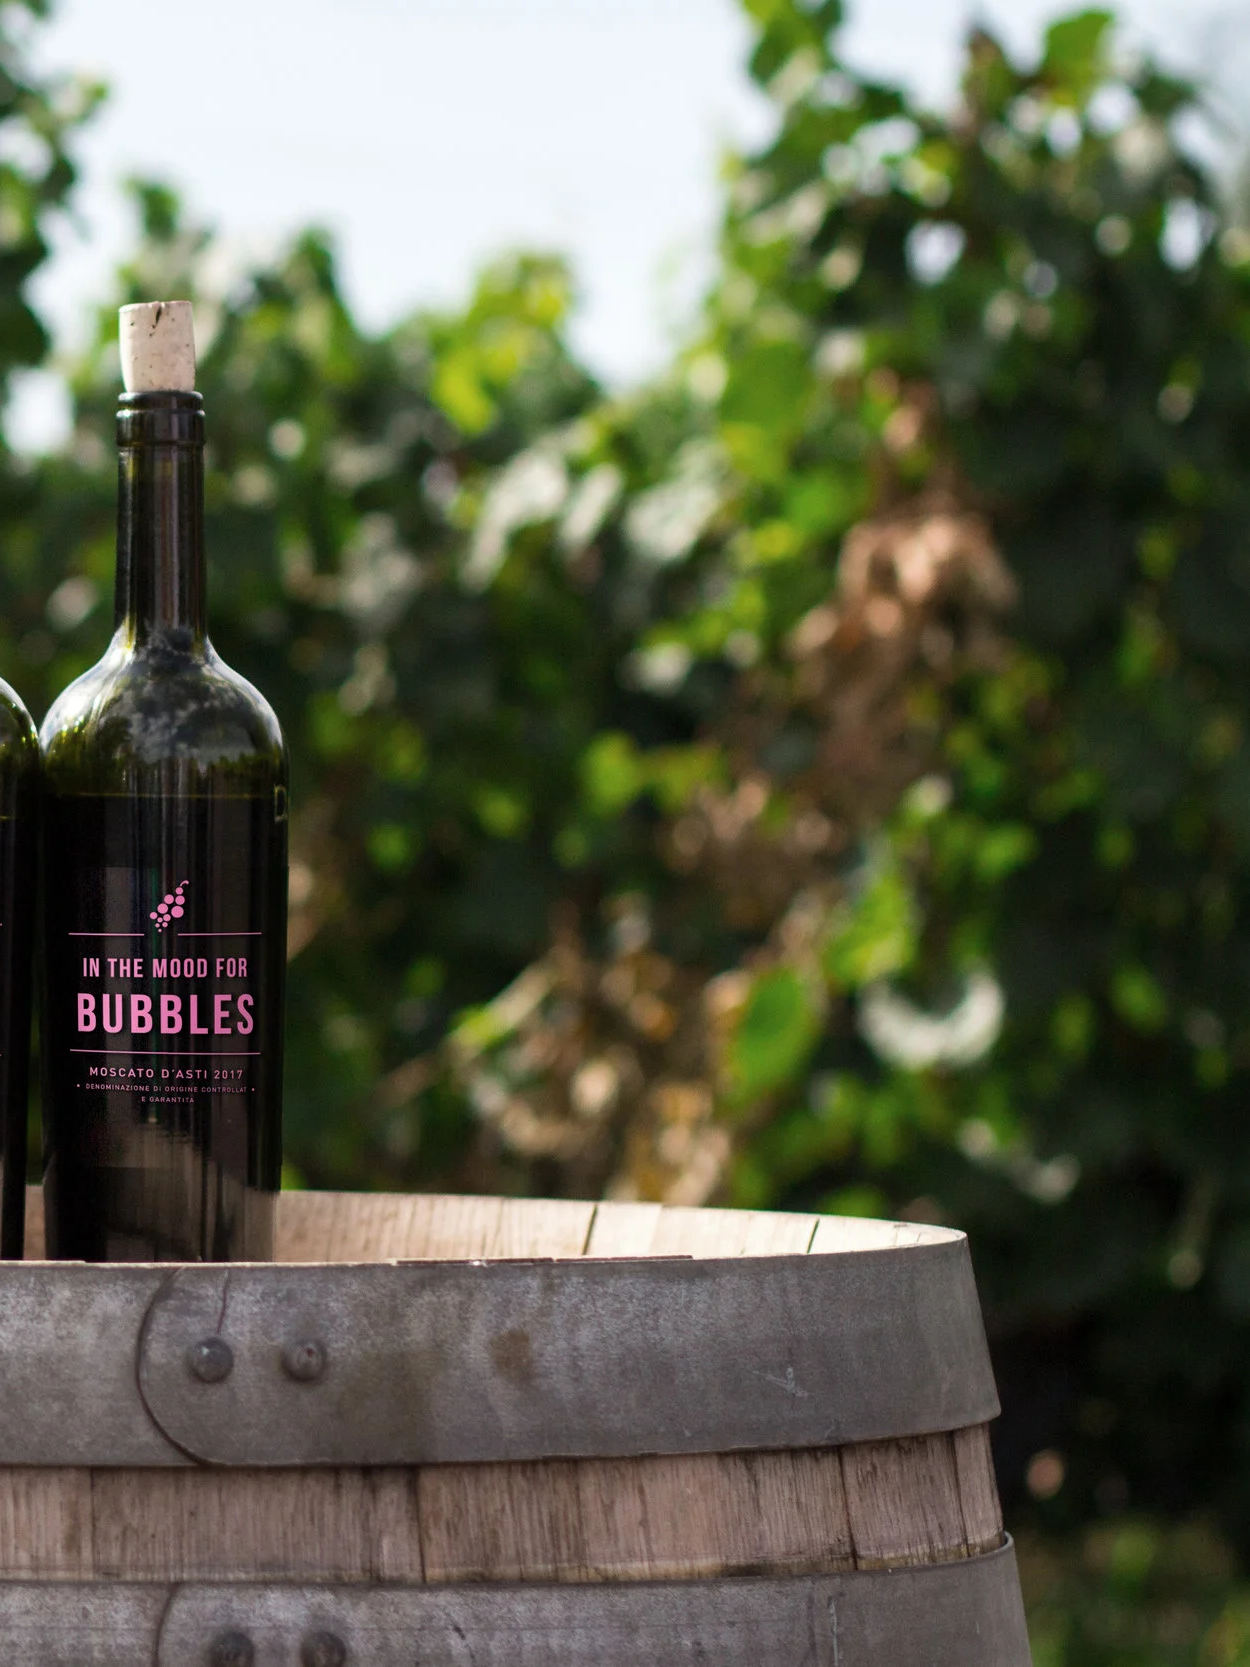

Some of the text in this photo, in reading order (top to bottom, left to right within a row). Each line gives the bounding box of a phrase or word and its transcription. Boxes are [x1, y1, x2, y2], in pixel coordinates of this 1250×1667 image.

[83, 957, 248, 978] IN THE MOOD FOR
[77, 993, 255, 1036] BUBBLES
[89, 1066, 244, 1080] MOSCATO D'ASTI 2017
[85, 1083, 150, 1092] DENOMINAZIONE
[164, 1085, 198, 1093] ORIGINE
